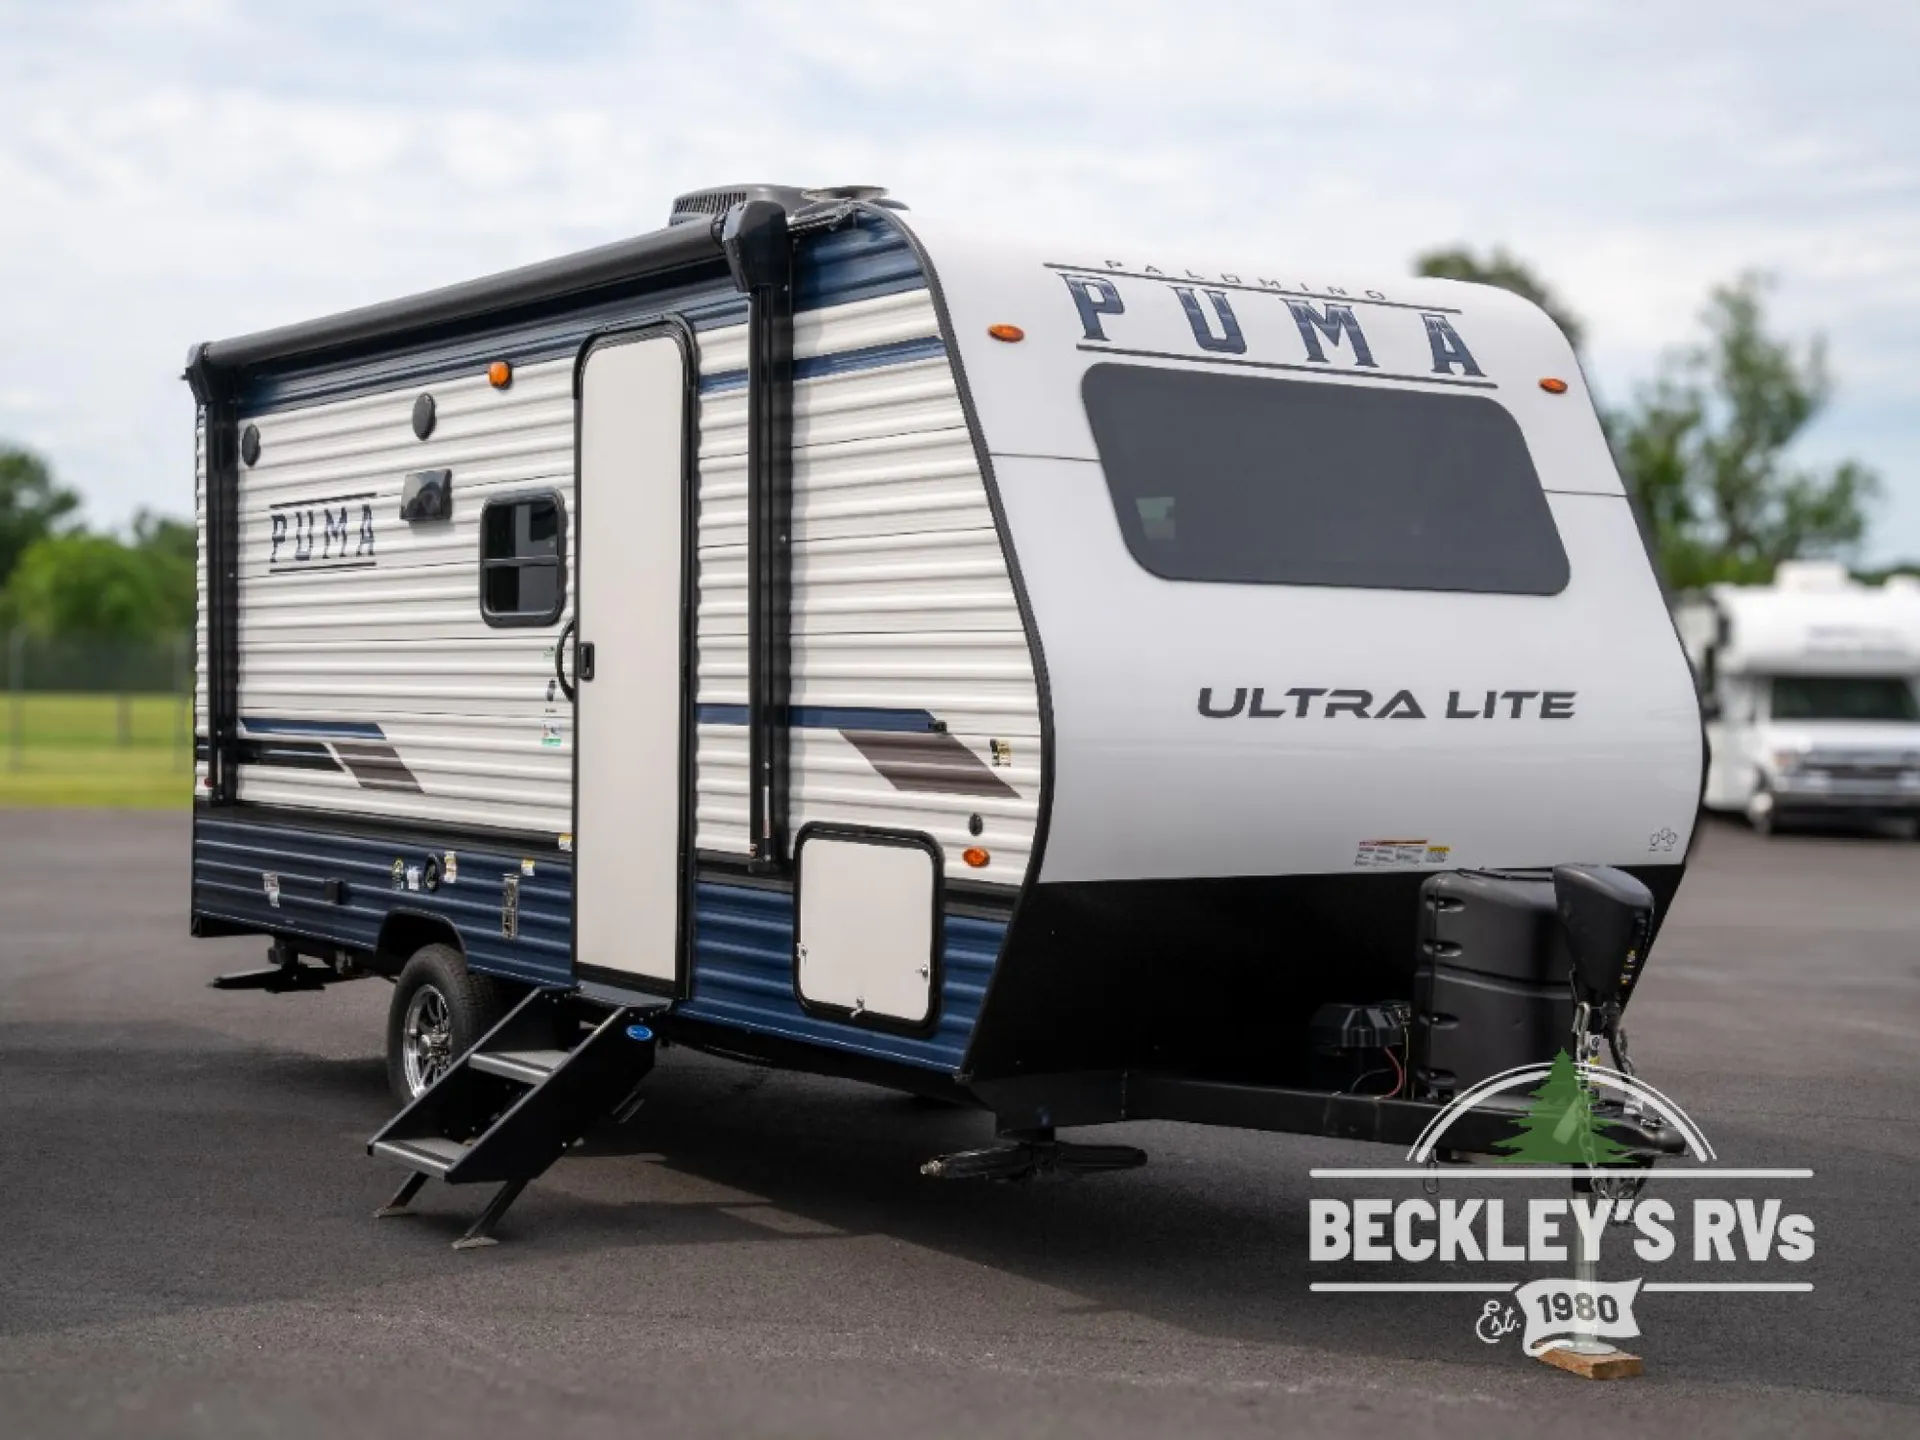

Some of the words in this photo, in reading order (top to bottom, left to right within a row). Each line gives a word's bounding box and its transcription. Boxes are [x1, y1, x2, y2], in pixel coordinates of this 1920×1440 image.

[1103, 259, 1387, 300] PALOMINO
[1056, 272, 1488, 377] PUMA
[269, 503, 376, 564] PUMA
[1197, 687, 1427, 719] ULTRA
[1445, 690, 1578, 720] LITE
